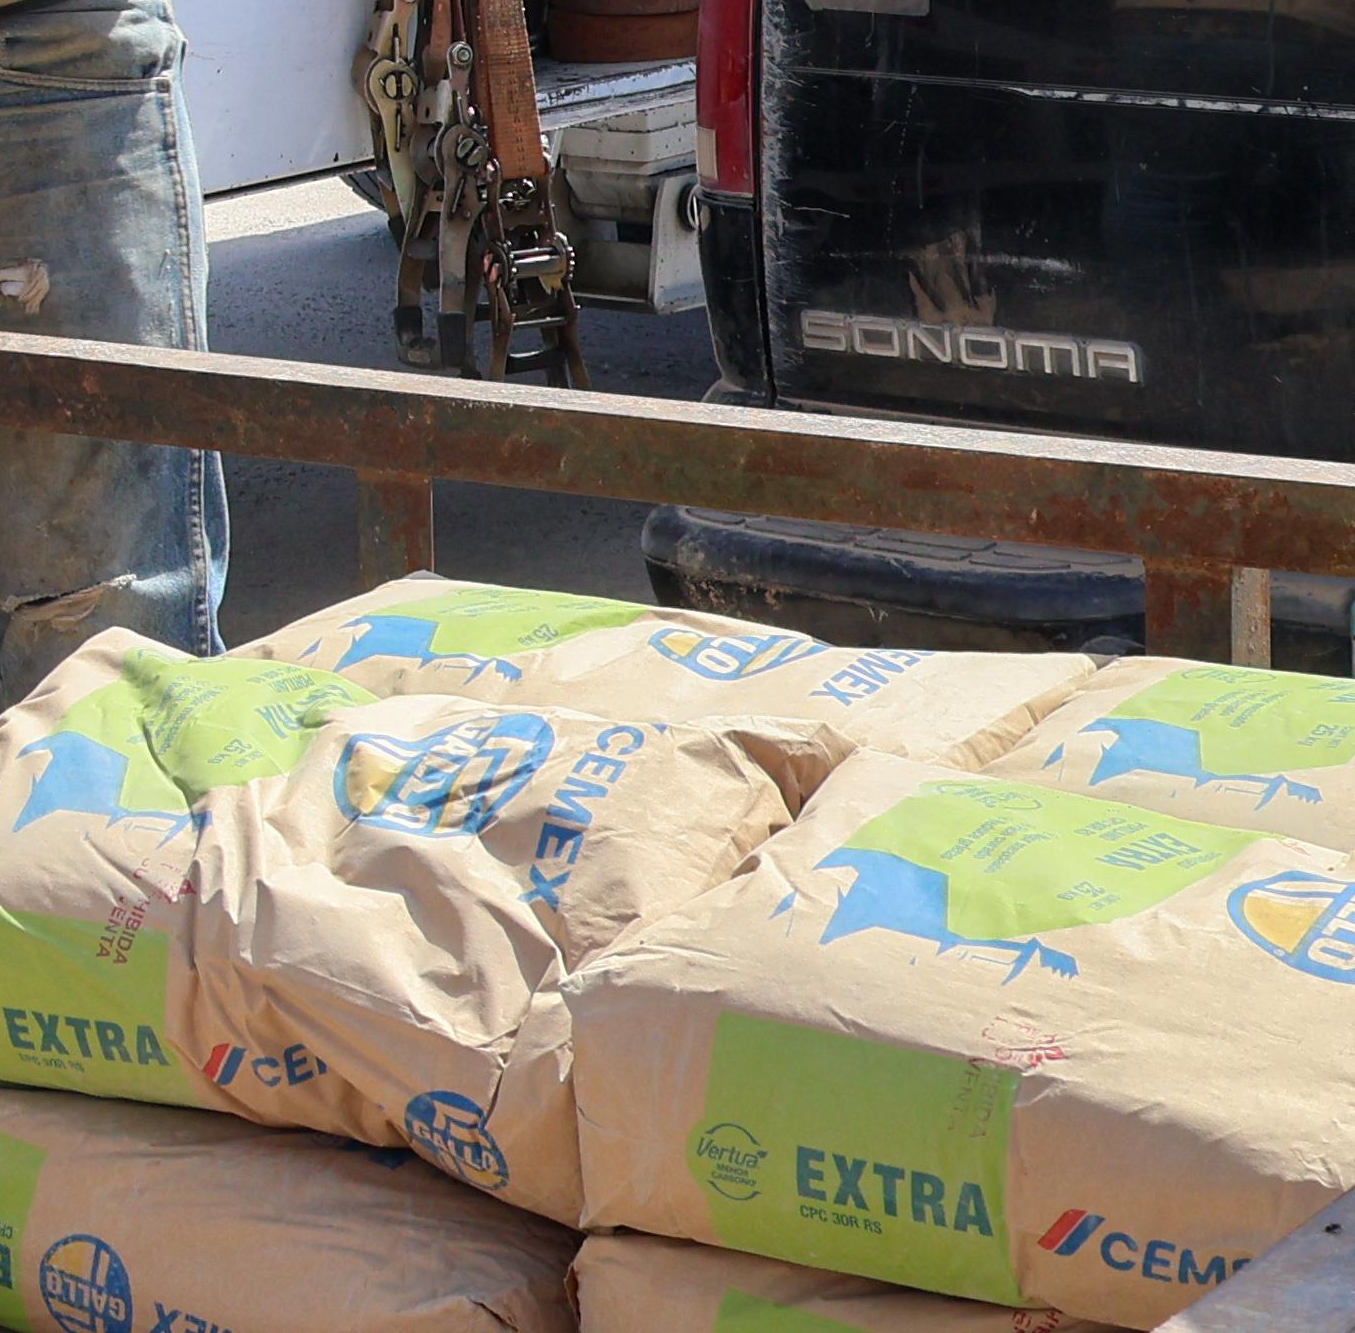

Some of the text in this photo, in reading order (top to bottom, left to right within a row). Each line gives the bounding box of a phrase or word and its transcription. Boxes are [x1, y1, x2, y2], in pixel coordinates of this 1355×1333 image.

[799, 309, 1142, 384] SONOMA
[808, 648, 937, 707] EMEX
[516, 724, 646, 914] CEMEX
[1095, 832, 1202, 871] EXTRA
[2, 1006, 171, 1068] EXTRA
[695, 1134, 1253, 1286] Vertua EXTRA CEM
[798, 1204, 884, 1236] CPC 30R RS
[45, 1269, 127, 1318] GALLO
